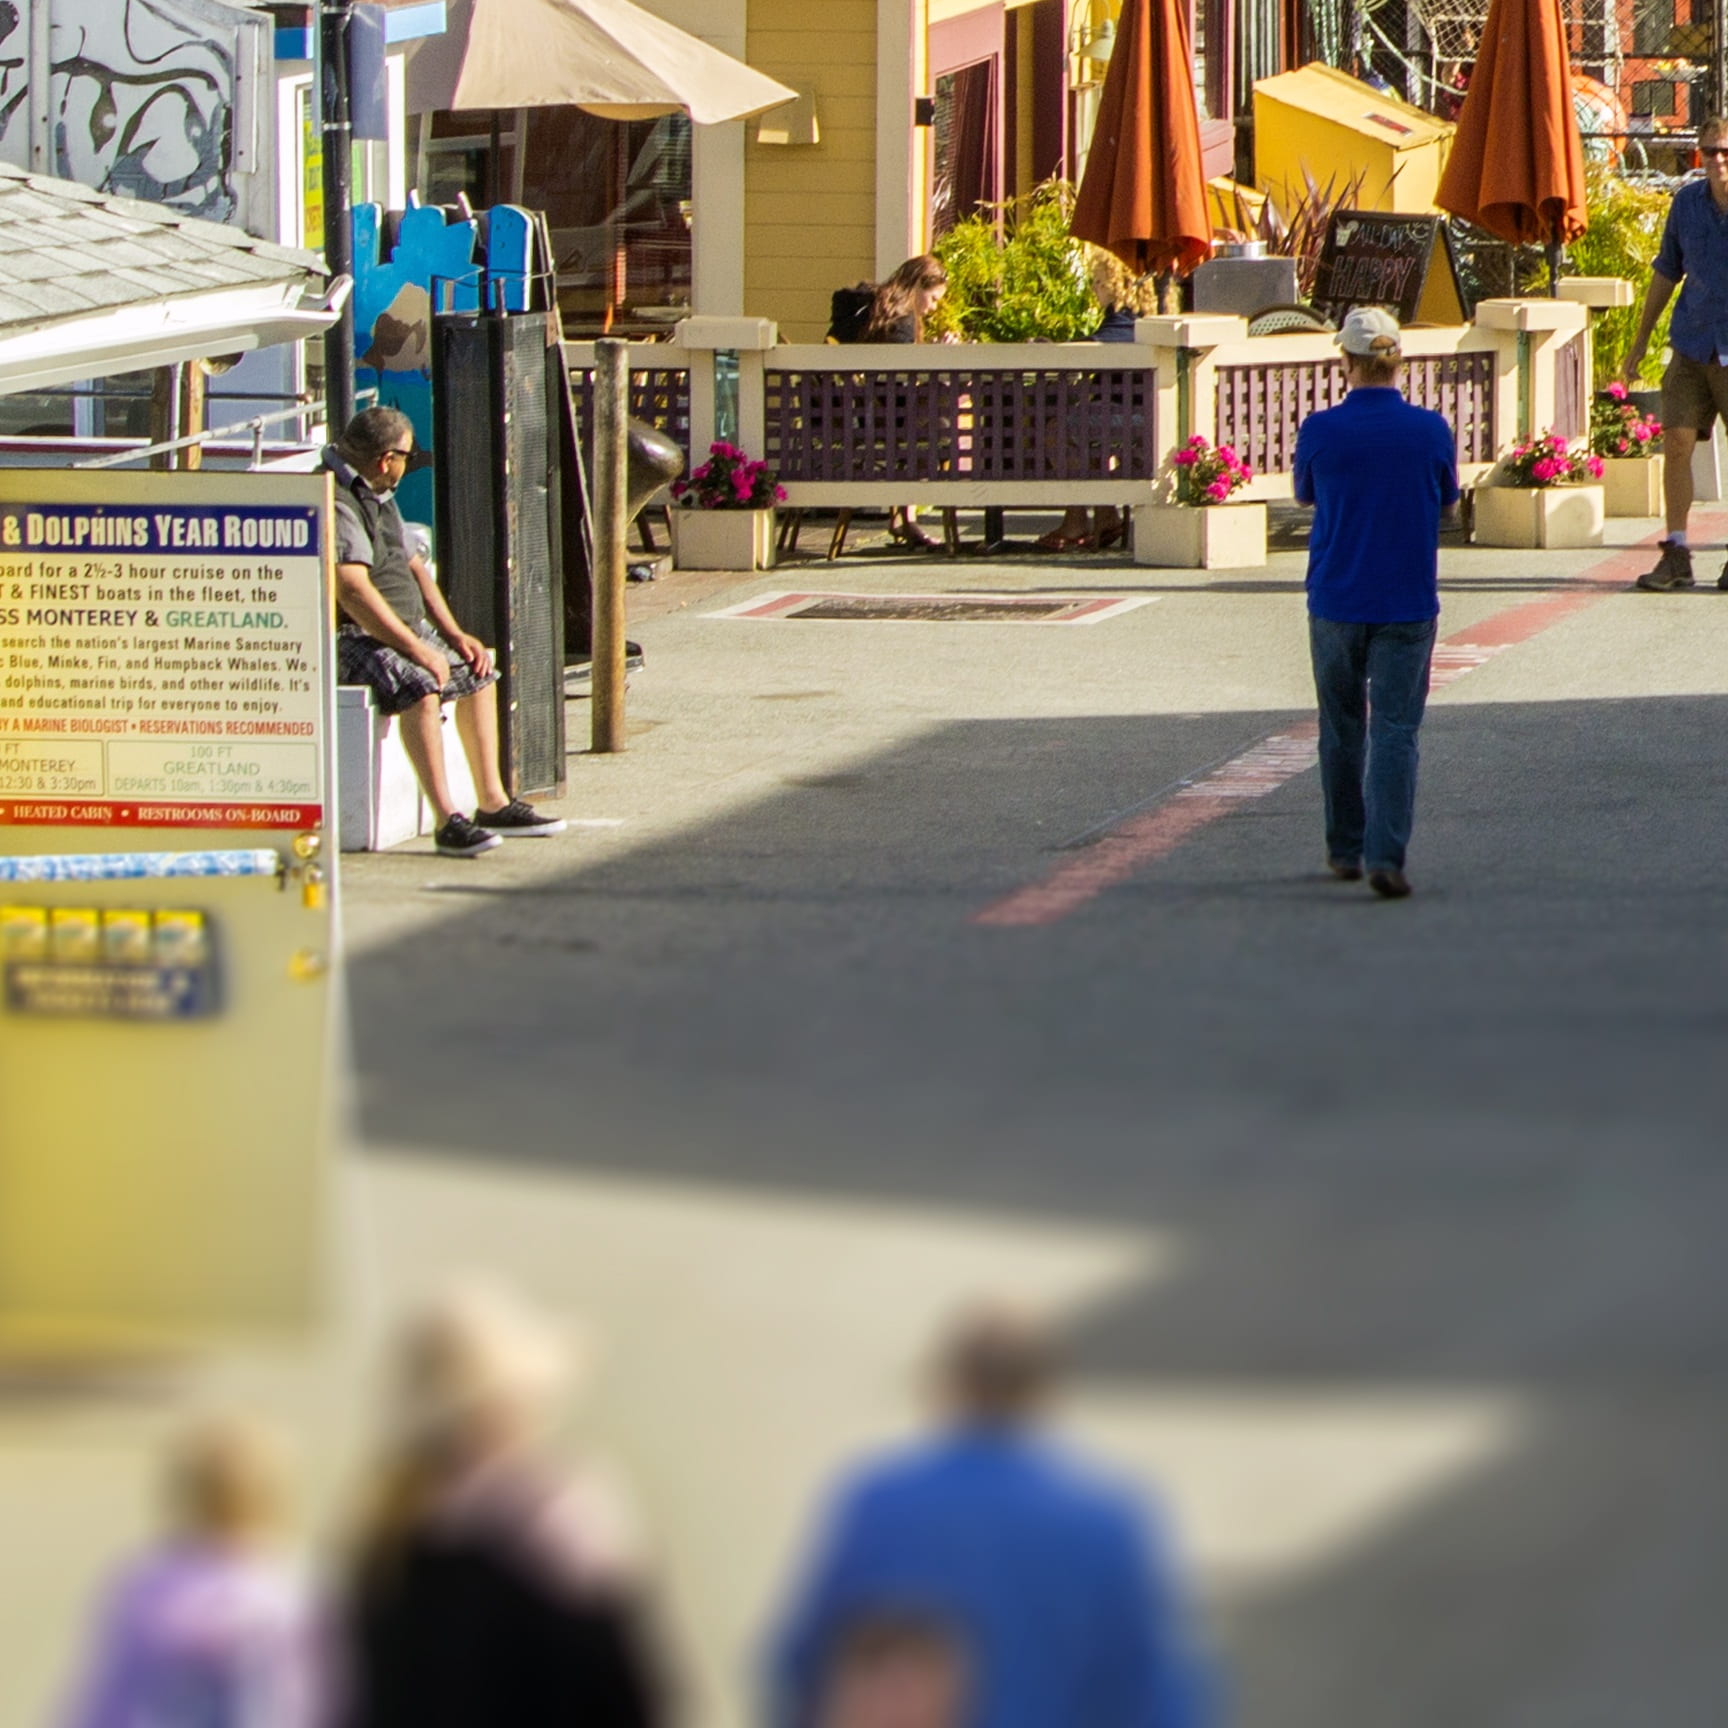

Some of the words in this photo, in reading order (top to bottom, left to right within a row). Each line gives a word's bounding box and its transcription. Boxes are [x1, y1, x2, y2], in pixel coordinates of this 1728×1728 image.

[1328, 255, 1416, 301] HAPPY
[3, 515, 21, 545] &
[27, 513, 149, 546] DOLPHINS
[154, 514, 219, 547] YEAR
[224, 515, 309, 548] ROUND
[39, 562, 63, 578] for
[69, 566, 78, 578] a
[129, 563, 167, 579] hour
[172, 564, 225, 580] cruise
[231, 568, 251, 580] on
[257, 564, 284, 580] the
[10, 584, 23, 600] &
[30, 584, 91, 600] FINEST
[96, 585, 142, 601] boats
[148, 586, 164, 601] in
[169, 586, 195, 602] the
[202, 586, 246, 604] fleet,
[251, 588, 278, 603] the
[26, 609, 138, 627] MONTEREY
[145, 610, 159, 627] &
[165, 610, 289, 629] GREATLAND.
[2, 636, 46, 649] search
[51, 635, 71, 649] the
[75, 636, 129, 650] nation's
[133, 636, 179, 653] largest
[184, 637, 231, 651] Marine
[235, 637, 303, 654] Sanctuary
[9, 655, 44, 670] Blue,
[48, 655, 93, 670] Minke,
[98, 656, 121, 671] Fin,
[125, 657, 149, 670] and
[154, 657, 223, 673] Humpback
[286, 658, 308, 672] We
[5, 675, 66, 691] dolphins,
[70, 676, 115, 689] marine
[119, 676, 158, 691] birds,
[162, 678, 186, 690] and
[190, 678, 224, 691] other
[289, 679, 311, 692] It's
[0, 695, 24, 708] and
[28, 695, 107, 709] educational
[111, 697, 134, 712] trip
[138, 697, 156, 710] for
[161, 699, 220, 713] everyone
[225, 700, 238, 711] to
[12, 718, 20, 732] A
[23, 718, 67, 733] MARINE
[70, 719, 129, 733] BIOLOGIST
[139, 720, 223, 735] RESERVATIONS
[225, 721, 315, 736] RECOMMENDED
[5, 743, 21, 754] FT
[0, 759, 76, 772] MONTEREY
[163, 761, 261, 775] GREATLAND
[13, 805, 67, 819] HEATED
[70, 806, 113, 820] CABIN
[138, 807, 223, 821] RESTROOMS
[225, 808, 301, 822] ON-BOARD
